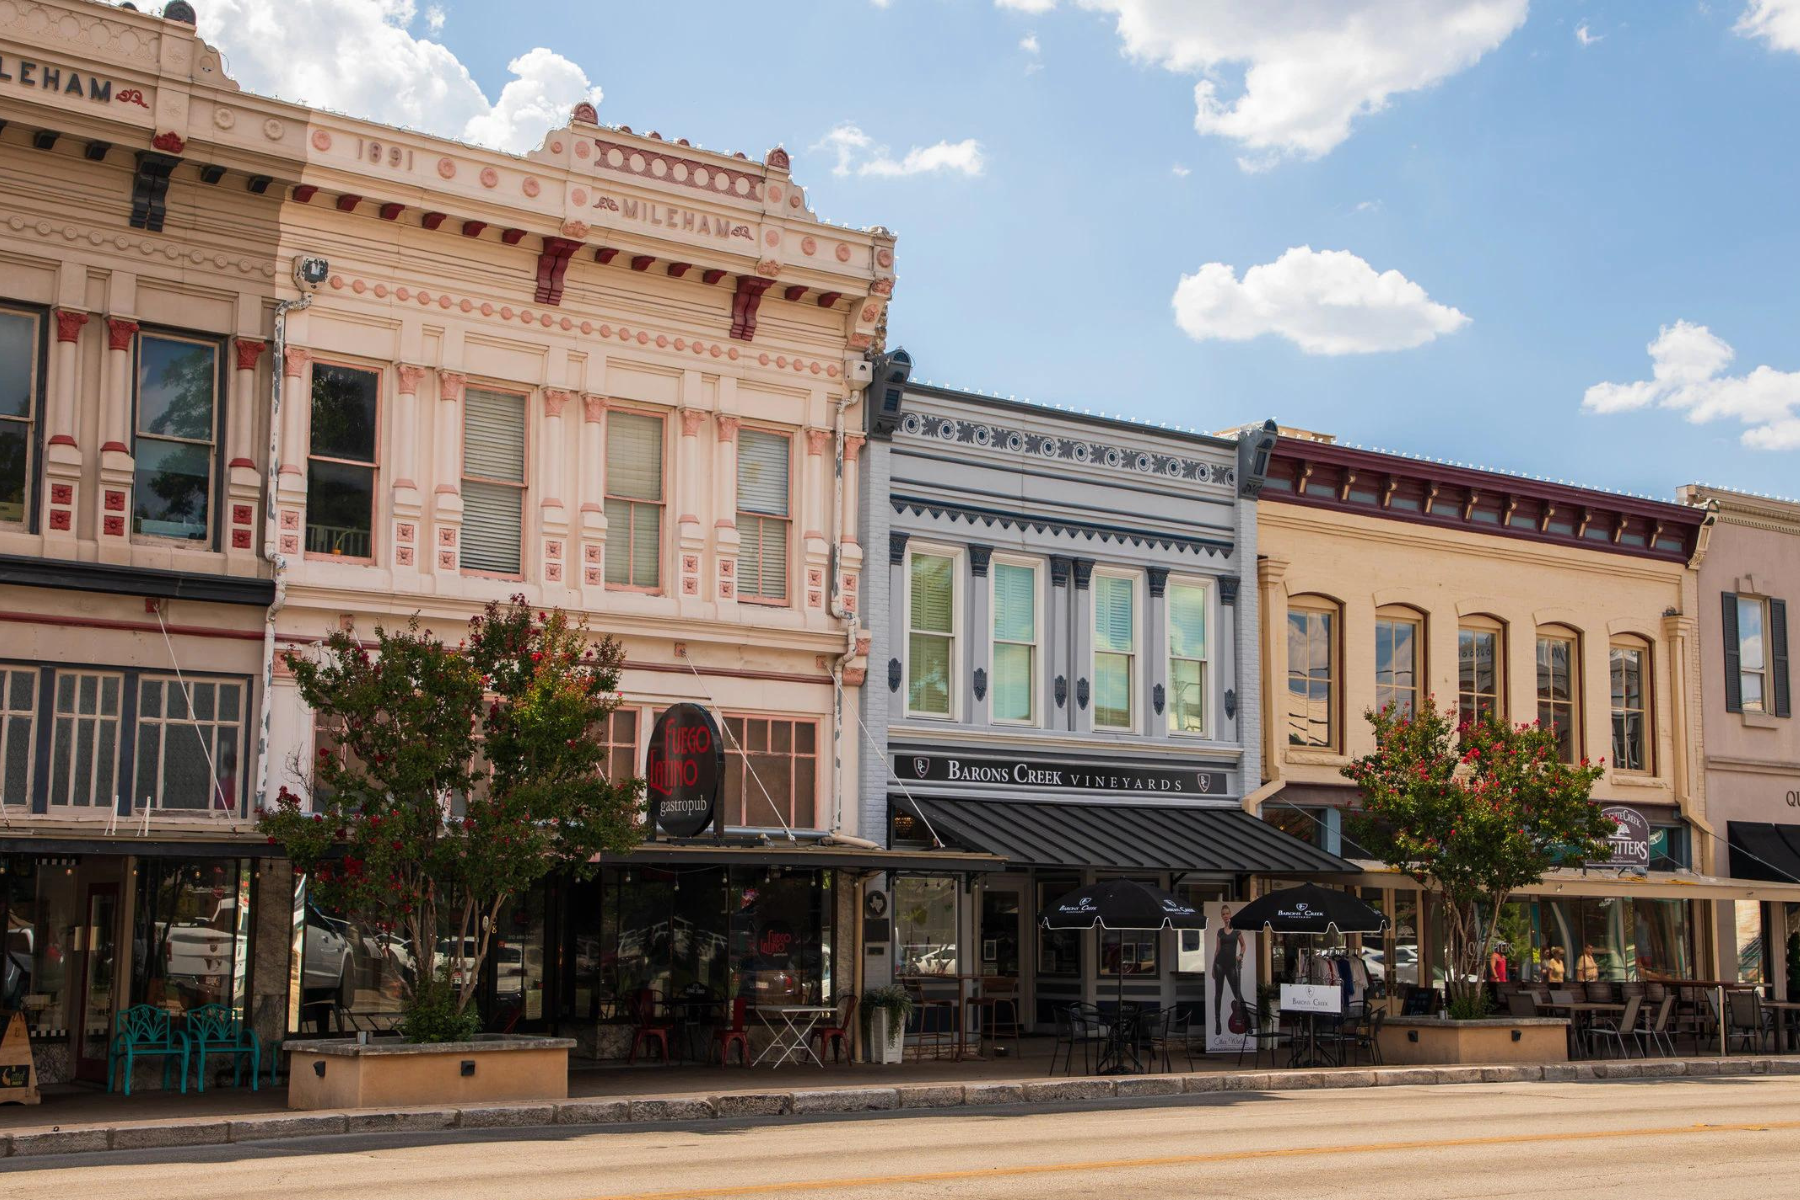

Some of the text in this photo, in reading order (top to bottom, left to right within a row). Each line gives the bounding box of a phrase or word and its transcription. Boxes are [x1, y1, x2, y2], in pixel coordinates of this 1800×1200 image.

[357, 138, 413, 171] 1891
[622, 198, 731, 239] MILEHAM
[947, 760, 1182, 791] BARONS CREEK VINEYARDS
[660, 795, 707, 817] gastropub
